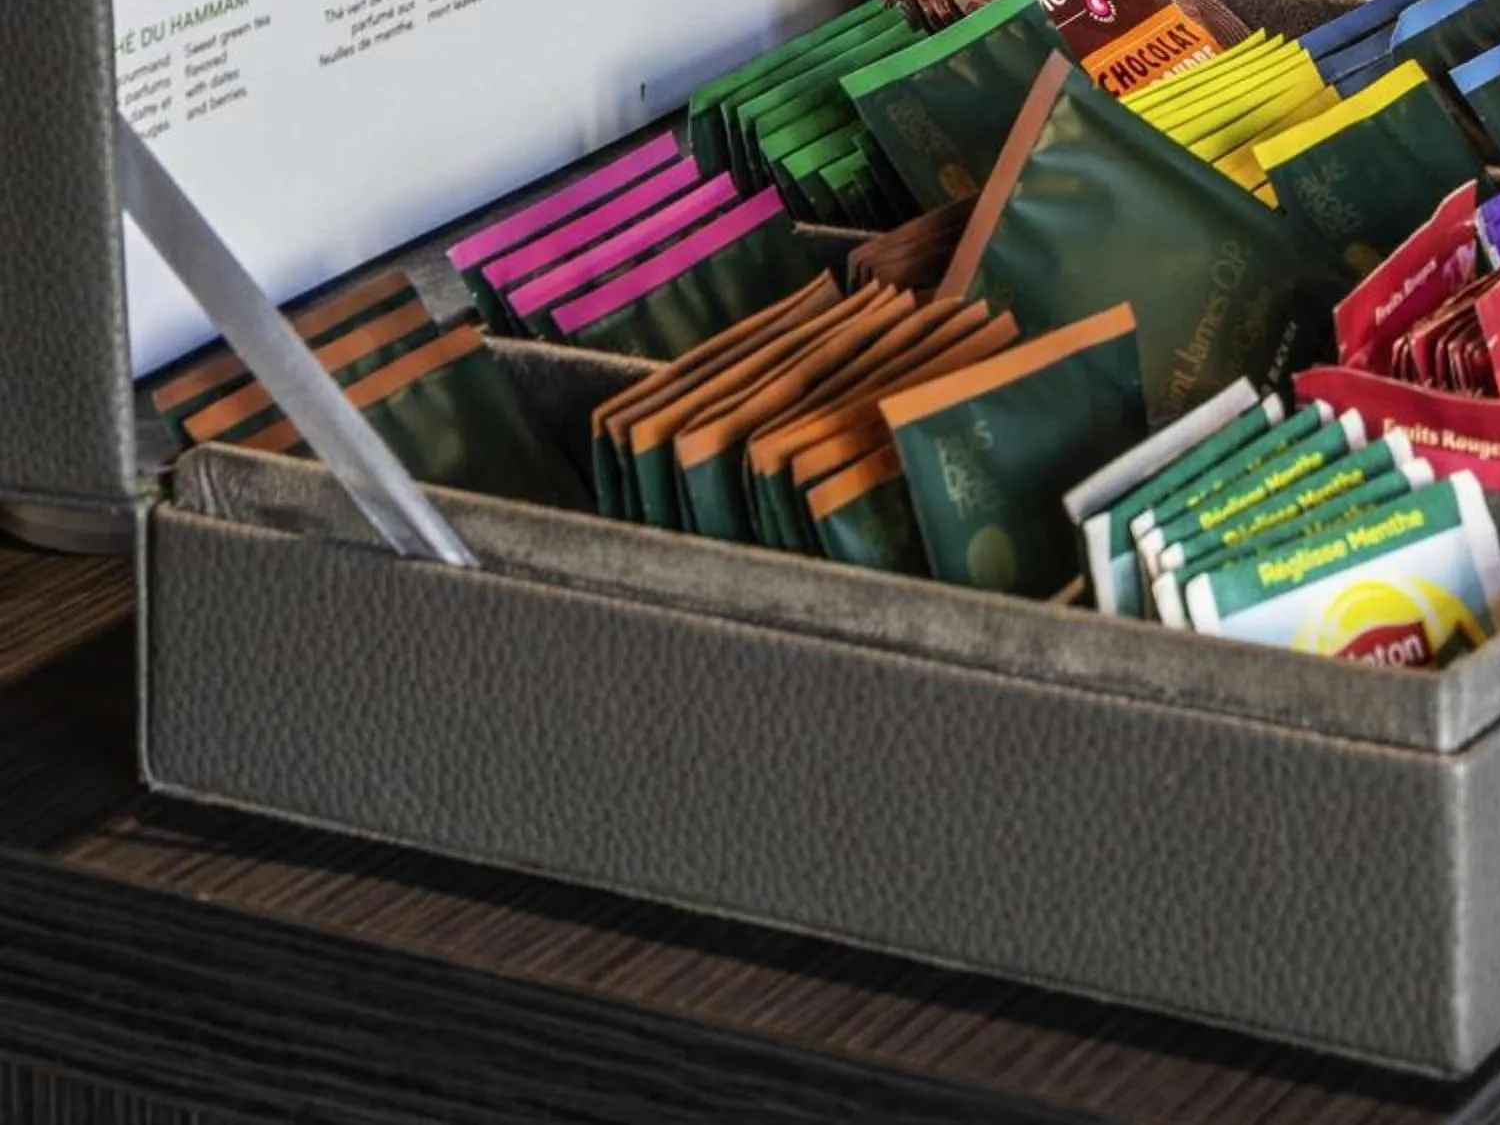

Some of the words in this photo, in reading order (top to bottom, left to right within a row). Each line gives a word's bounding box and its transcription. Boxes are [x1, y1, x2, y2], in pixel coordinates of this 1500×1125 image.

[140, 20, 165, 49] DU
[1098, 23, 1200, 95] CHOCOLAT
[1257, 539, 1347, 589] Réglisse
[1346, 509, 1425, 551] Menthe
